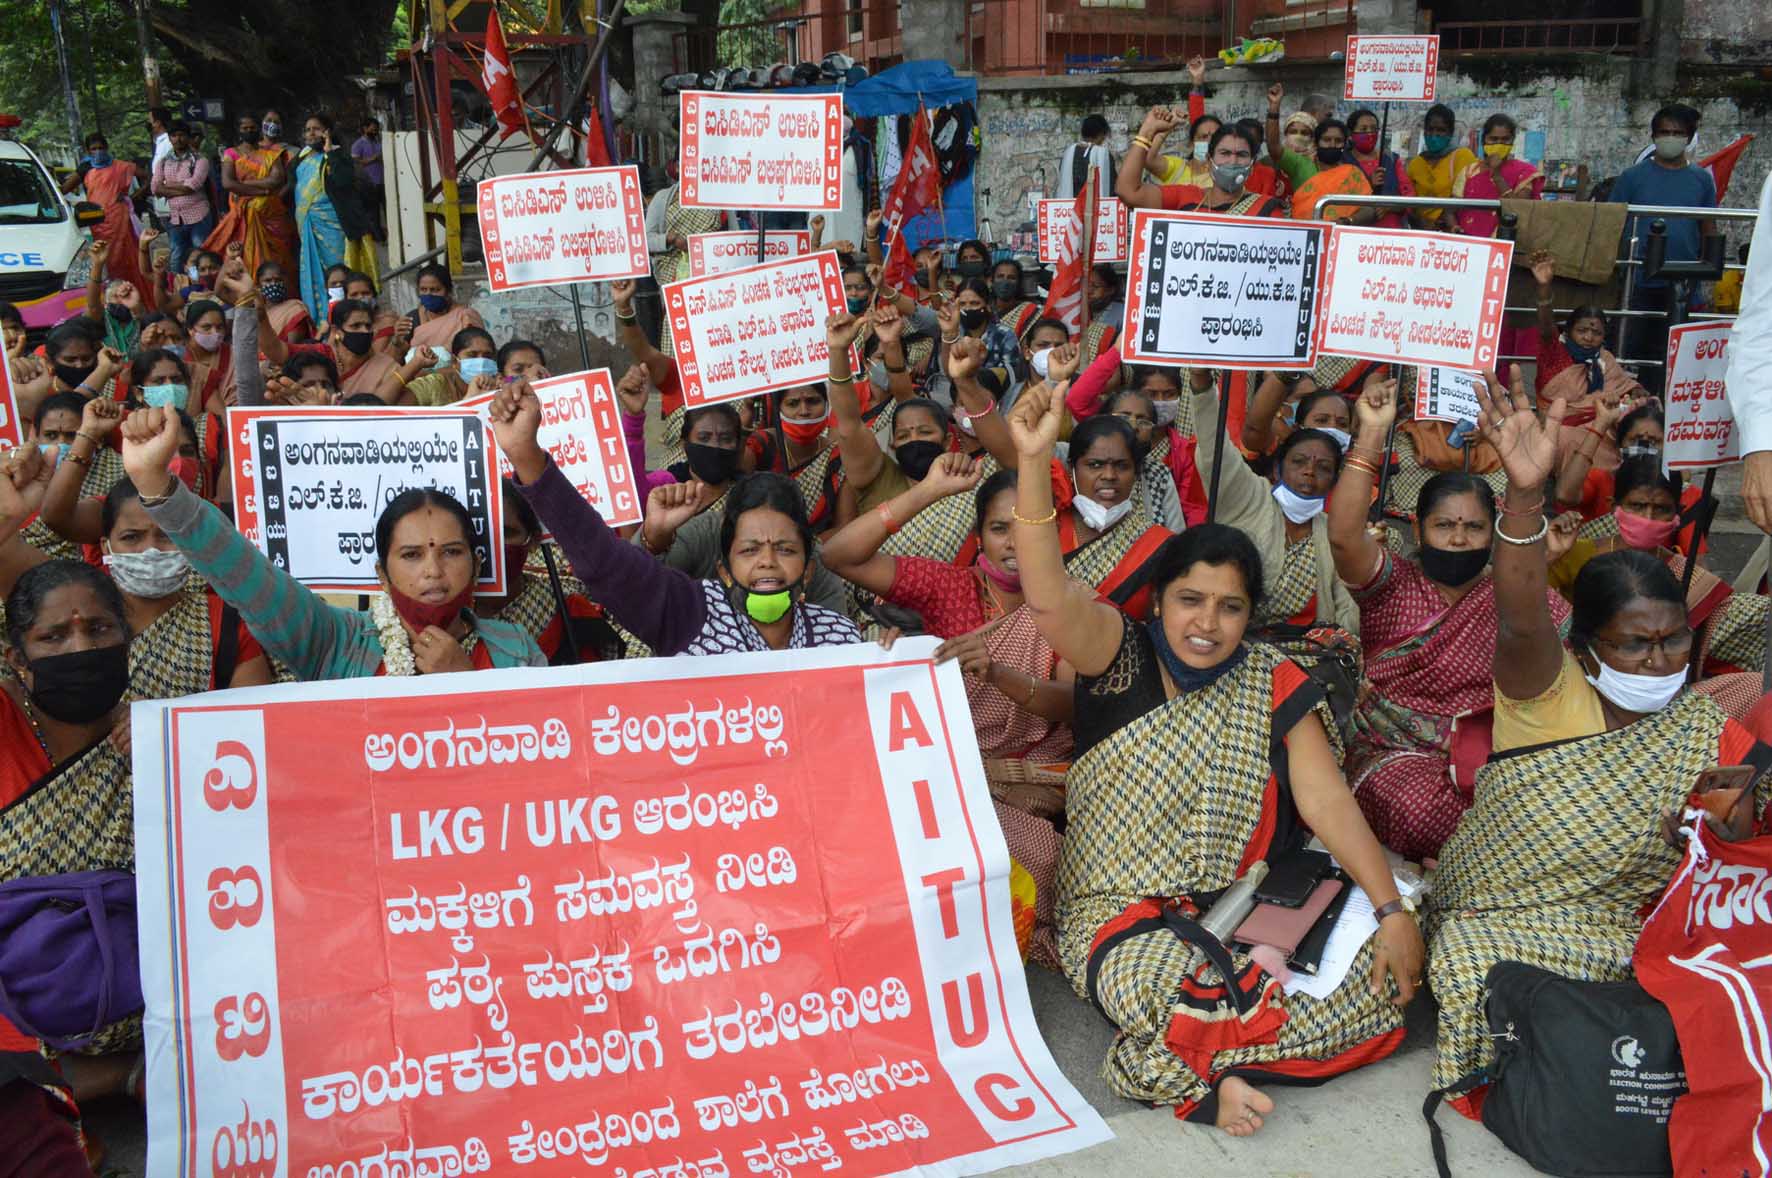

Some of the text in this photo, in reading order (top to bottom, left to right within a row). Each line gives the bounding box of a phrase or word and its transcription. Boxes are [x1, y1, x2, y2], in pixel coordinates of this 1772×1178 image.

[1425, 41, 1436, 96] AITUC
[704, 105, 820, 139] ಐಸಿಡಿಎಸ್ ಉಳಿಸಿ
[827, 104, 839, 201] AITUC
[502, 180, 617, 218] ಐಸಿಡಿಎಸ್ ಉಳಿಸಿ
[701, 152, 751, 185] ಐಸಿಡಿಎಸ್
[504, 228, 555, 265] ಐಸಿಡಿಎಸ್
[624, 175, 646, 268] AITUC
[1357, 240, 1416, 266] ಅಂಗನವಾಡಿ
[1170, 239, 1303, 272] ಅಂಗನವಾಡಿಯಲ್ಲಿಯೇ
[1297, 240, 1316, 347] AITUC
[1478, 252, 1504, 363] AITUC
[1200, 313, 1264, 344] ಪ್ರಾರಂಭಿಸಿ
[284, 431, 458, 473] ಅಂಗನವಾಡಿಯಲ್ಲಿಯೇ
[593, 384, 633, 512] AITUC
[364, 695, 788, 772] ಅಂಗನವಾಡಿ ಕೇಂದ್ರಗಳಲ್ಲಿ
[390, 806, 485, 860] LKG
[526, 795, 622, 847] UKG
[633, 782, 779, 836] ಆರಂಭಿಸಿ
[385, 846, 798, 952] ಮಕ್ಕಳಿಗೆ ಸಮವಸ್ತ್ರ ನೀಡಿ
[888, 690, 1038, 1122] AITUC
[426, 921, 782, 1031] ಪಠ್ಯ ಪುಸ್ತಕ ಒದಗಿಸಿ
[301, 976, 912, 1120] ಕಾರ್ಯಕರ್ತೆಯರಿಗೆ ತರಬೇತಿನೀಡಿ
[507, 1096, 681, 1166] ಕೇಂದ್ರದಿಂದ
[694, 1075, 790, 1131] ಶಾಲೆಗೆ
[799, 1054, 931, 1111] ಹೋಗಲು
[1609, 1080, 1642, 1088] ELECTION
[1640, 1107, 1660, 1115] LEVEL
[845, 1111, 931, 1151] ಮಾಡಿ
